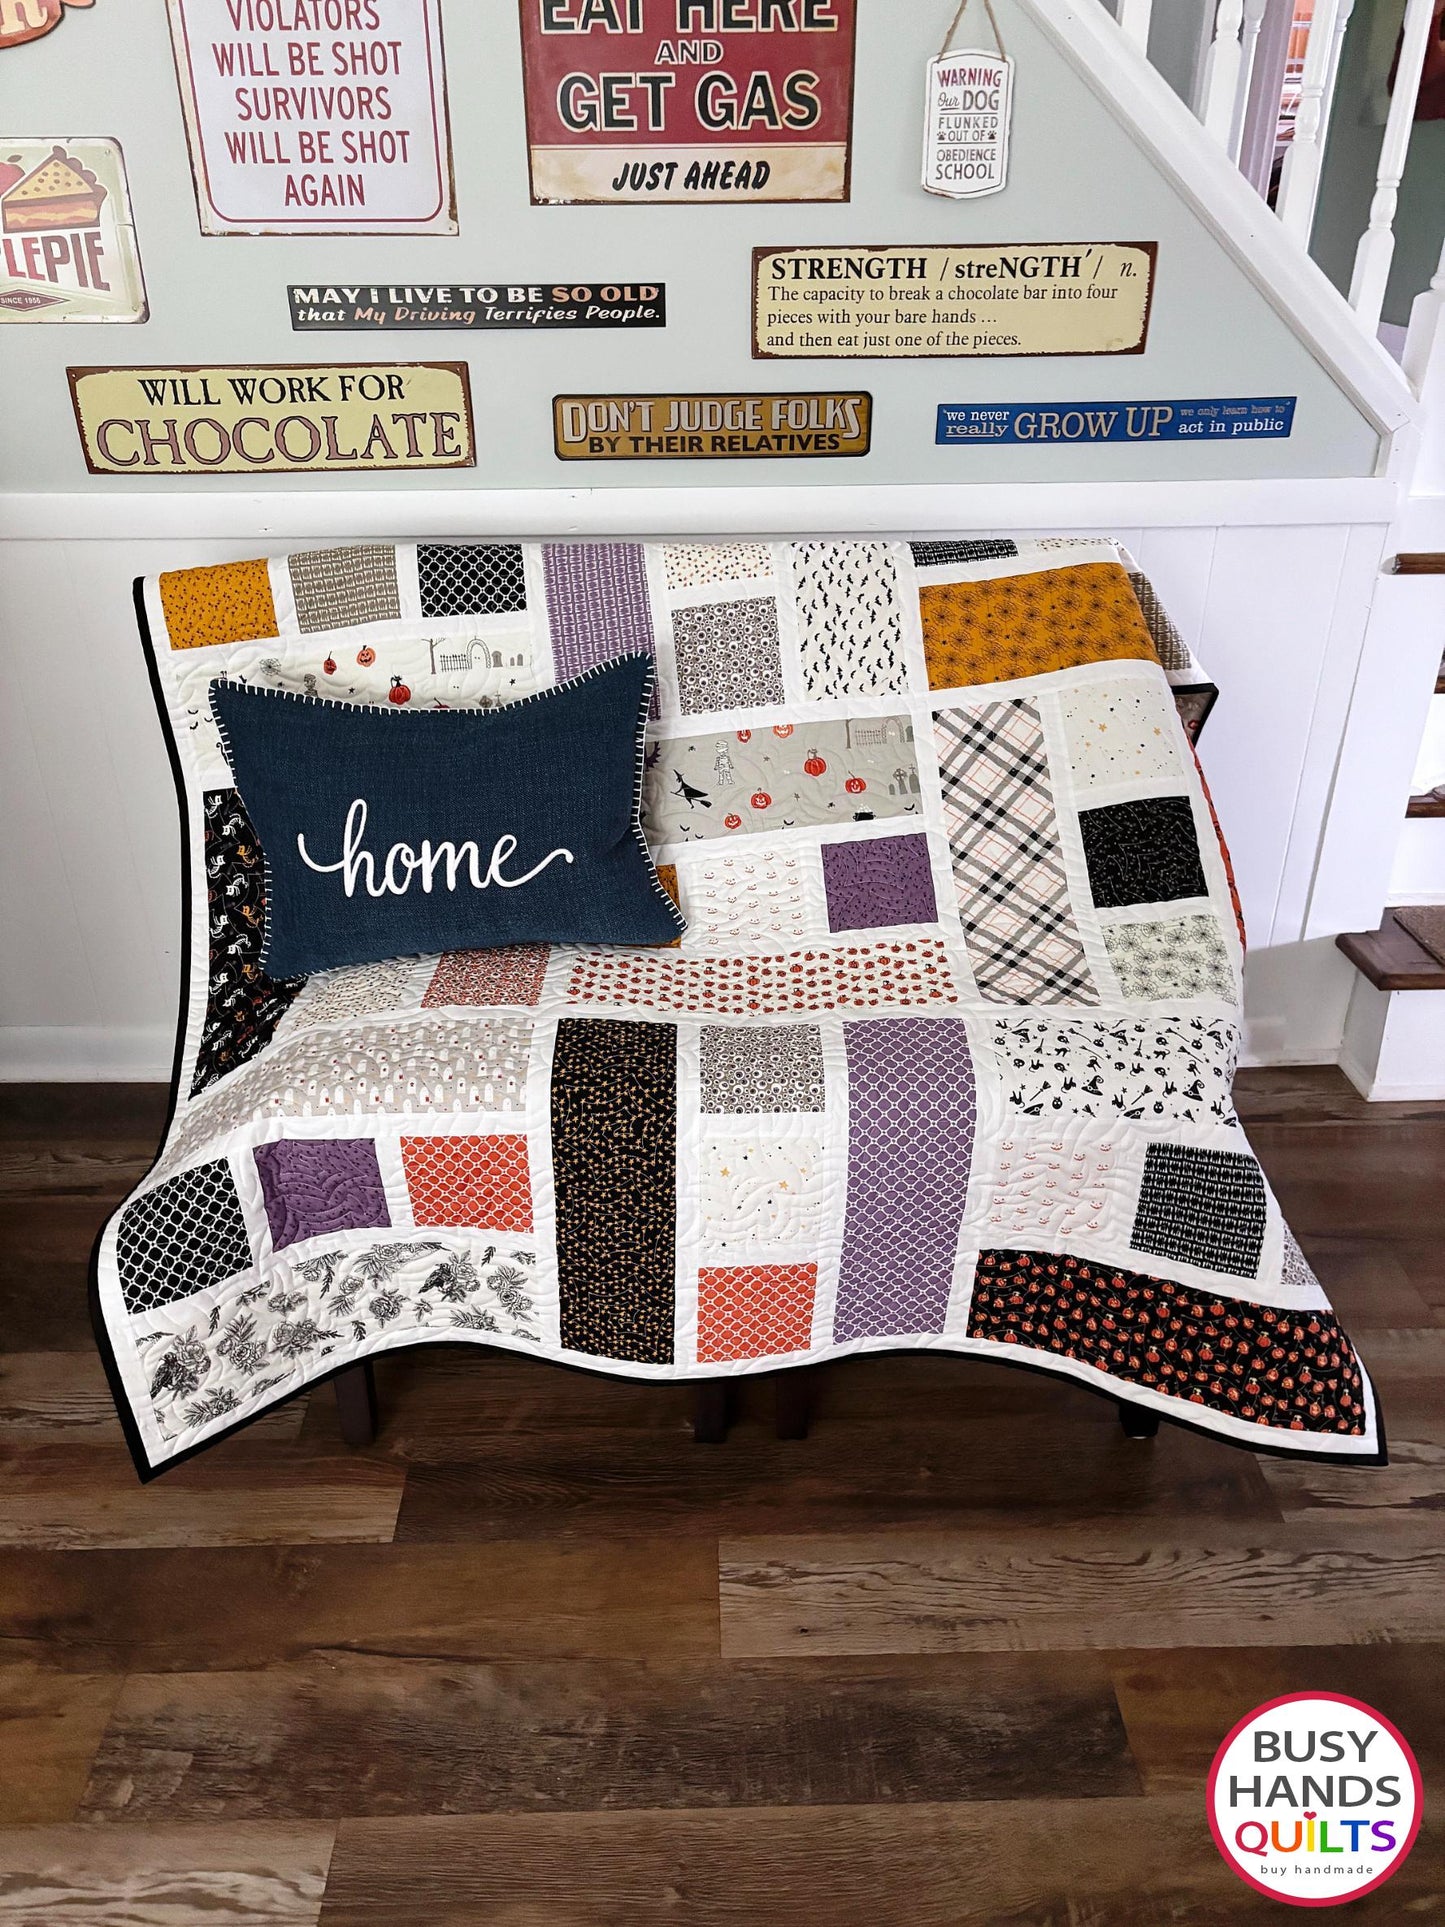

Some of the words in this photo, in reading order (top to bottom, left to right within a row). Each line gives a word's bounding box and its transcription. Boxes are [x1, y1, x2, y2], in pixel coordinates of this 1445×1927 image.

[227, 0, 380, 31] VIOLATORS
[540, 0, 644, 34] EAT
[676, 0, 839, 33] HERE
[211, 42, 280, 77] WILL
[288, 41, 325, 76] BE
[333, 41, 402, 76] SHOT
[655, 40, 723, 65] AND
[937, 68, 1003, 88] WARNING
[235, 86, 392, 121] SURVIVORS
[557, 71, 675, 132] GET
[695, 69, 822, 131] GAS
[937, 91, 960, 109] Our
[962, 90, 999, 111] DOG
[938, 116, 999, 129] FLUNKED
[948, 130, 969, 142] OUT
[972, 130, 986, 142] OF
[224, 131, 291, 164] WILL
[300, 131, 334, 164] BE
[342, 130, 410, 163] SHOT
[936, 148, 996, 162] OBEDIENCE
[612, 161, 678, 191] JUST
[684, 160, 771, 191] AHEAD
[935, 164, 995, 180] SCHOOL
[284, 174, 366, 207] AGAIN
[771, 257, 927, 281] STRENGTH
[1119, 260, 1138, 277] n.
[294, 288, 361, 305] MAY
[371, 288, 379, 304] I
[389, 287, 453, 304] LIVE
[459, 287, 498, 304] TO
[508, 287, 544, 303] BE
[551, 286, 592, 303] SO
[599, 286, 659, 302] OLD
[767, 286, 797, 301] The
[803, 286, 865, 304] capacity
[870, 287, 884, 301] to
[889, 285, 931, 301] break
[935, 290, 943, 300] a
[948, 284, 1019, 300] chocolate
[1023, 285, 1048, 300] bar
[1052, 285, 1082, 300] into
[1086, 284, 1118, 301] four
[297, 308, 346, 321] that
[354, 307, 385, 325] My
[394, 307, 476, 325] Driving
[485, 306, 577, 322] Terrifies
[585, 305, 660, 321] People.
[767, 310, 813, 328] pieces
[817, 309, 851, 324] with
[855, 312, 891, 327] your
[895, 309, 927, 324] bare
[931, 308, 977, 324] hands
[767, 332, 794, 347] and
[800, 332, 832, 347] then
[837, 334, 859, 347] eat
[863, 332, 890, 350] just
[895, 335, 922, 347] one
[926, 330, 944, 346] of
[945, 331, 969, 346] the
[972, 331, 1021, 349] pieces.
[137, 378, 222, 406] WILL
[227, 376, 332, 406] WORK
[339, 374, 406, 402] FOR
[562, 399, 655, 443] DON'T
[664, 399, 763, 432] JUDGE
[771, 398, 862, 439] FOLKS
[947, 411, 966, 421] we
[971, 411, 1010, 421] never
[1180, 408, 1194, 416] we
[1197, 406, 1219, 417] only
[1251, 404, 1272, 414] how
[1274, 404, 1285, 413] to
[946, 422, 1009, 438] really
[1014, 411, 1116, 440] GROW
[1125, 406, 1174, 438] UP
[1178, 421, 1204, 433] act
[1209, 420, 1226, 433] in
[1231, 418, 1284, 435] public
[96, 412, 462, 466] CHOCOLATE
[589, 436, 622, 454] BY
[628, 435, 708, 453] THEIR
[711, 433, 840, 453] RELATIVES
[298, 799, 573, 898] home
